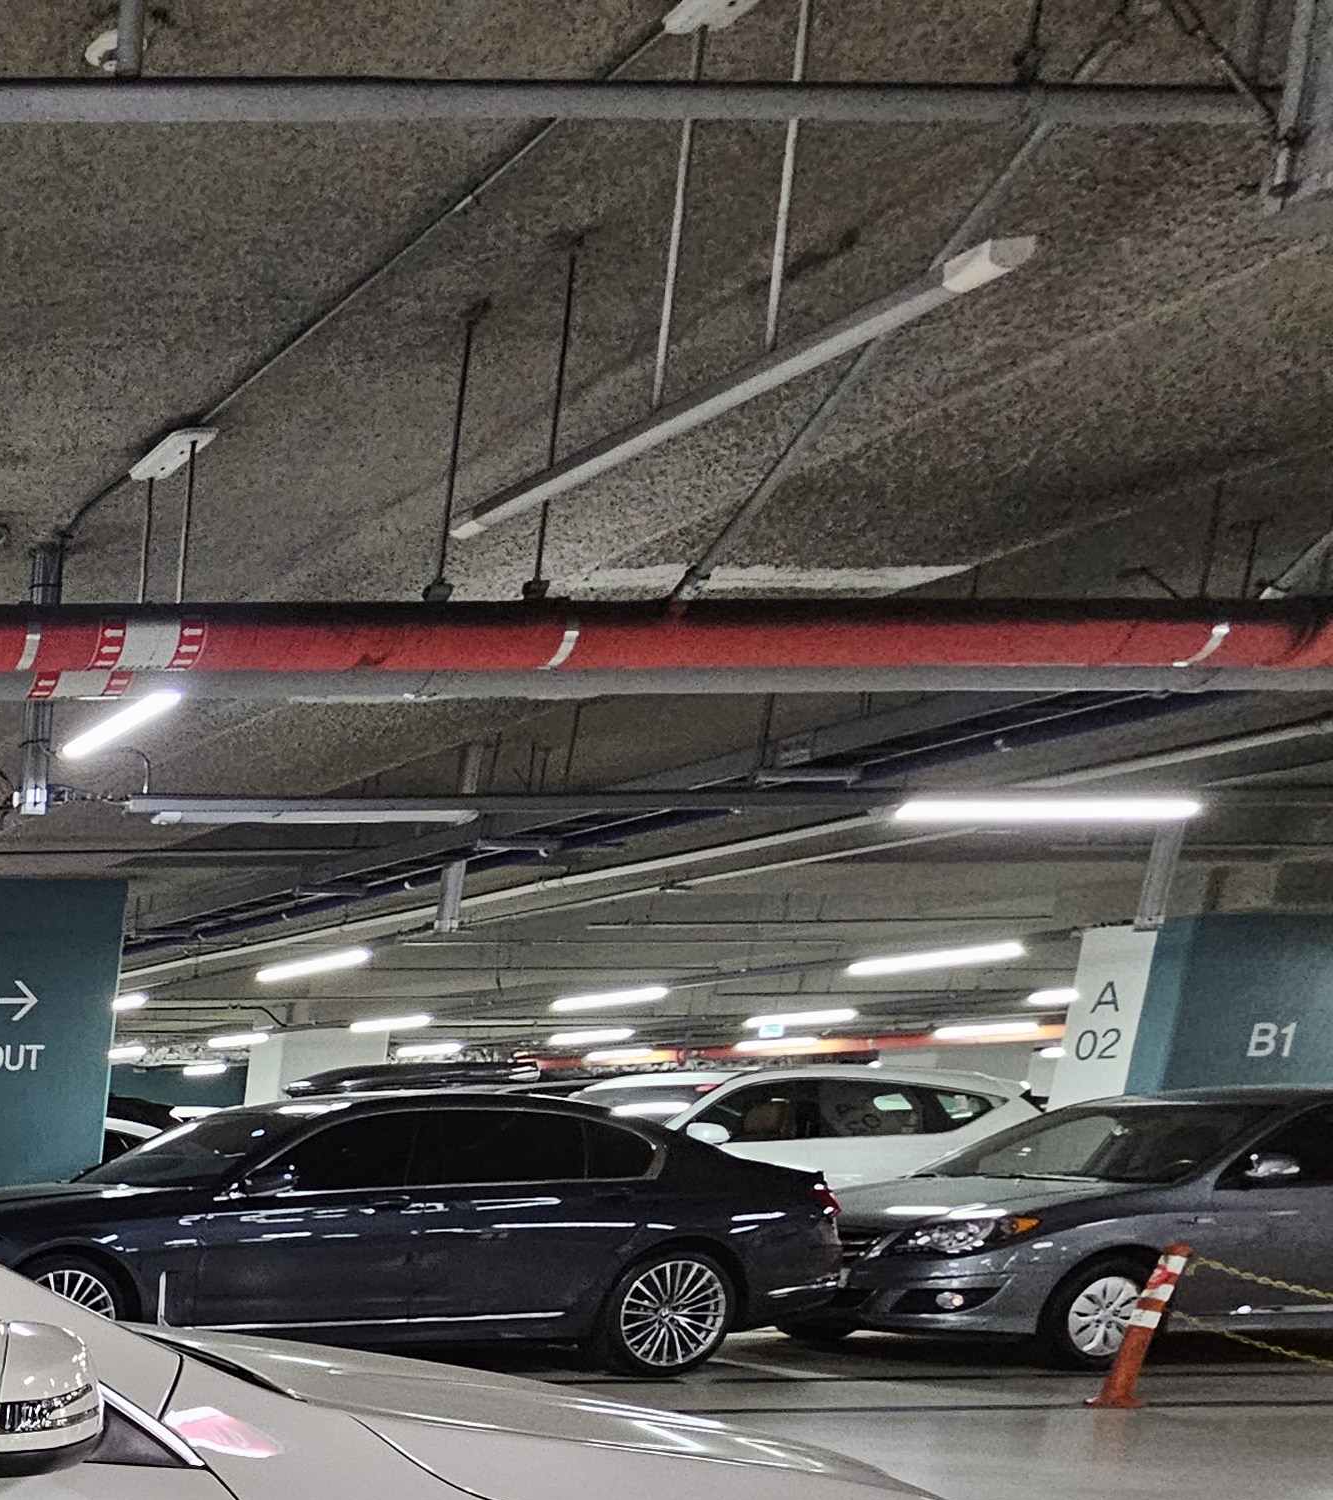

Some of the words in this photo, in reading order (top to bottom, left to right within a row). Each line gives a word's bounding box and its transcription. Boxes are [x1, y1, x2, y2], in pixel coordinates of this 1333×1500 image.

[1090, 980, 1120, 1014] A
[1075, 1027, 1122, 1061] 02
[1246, 1021, 1298, 1057] B1
